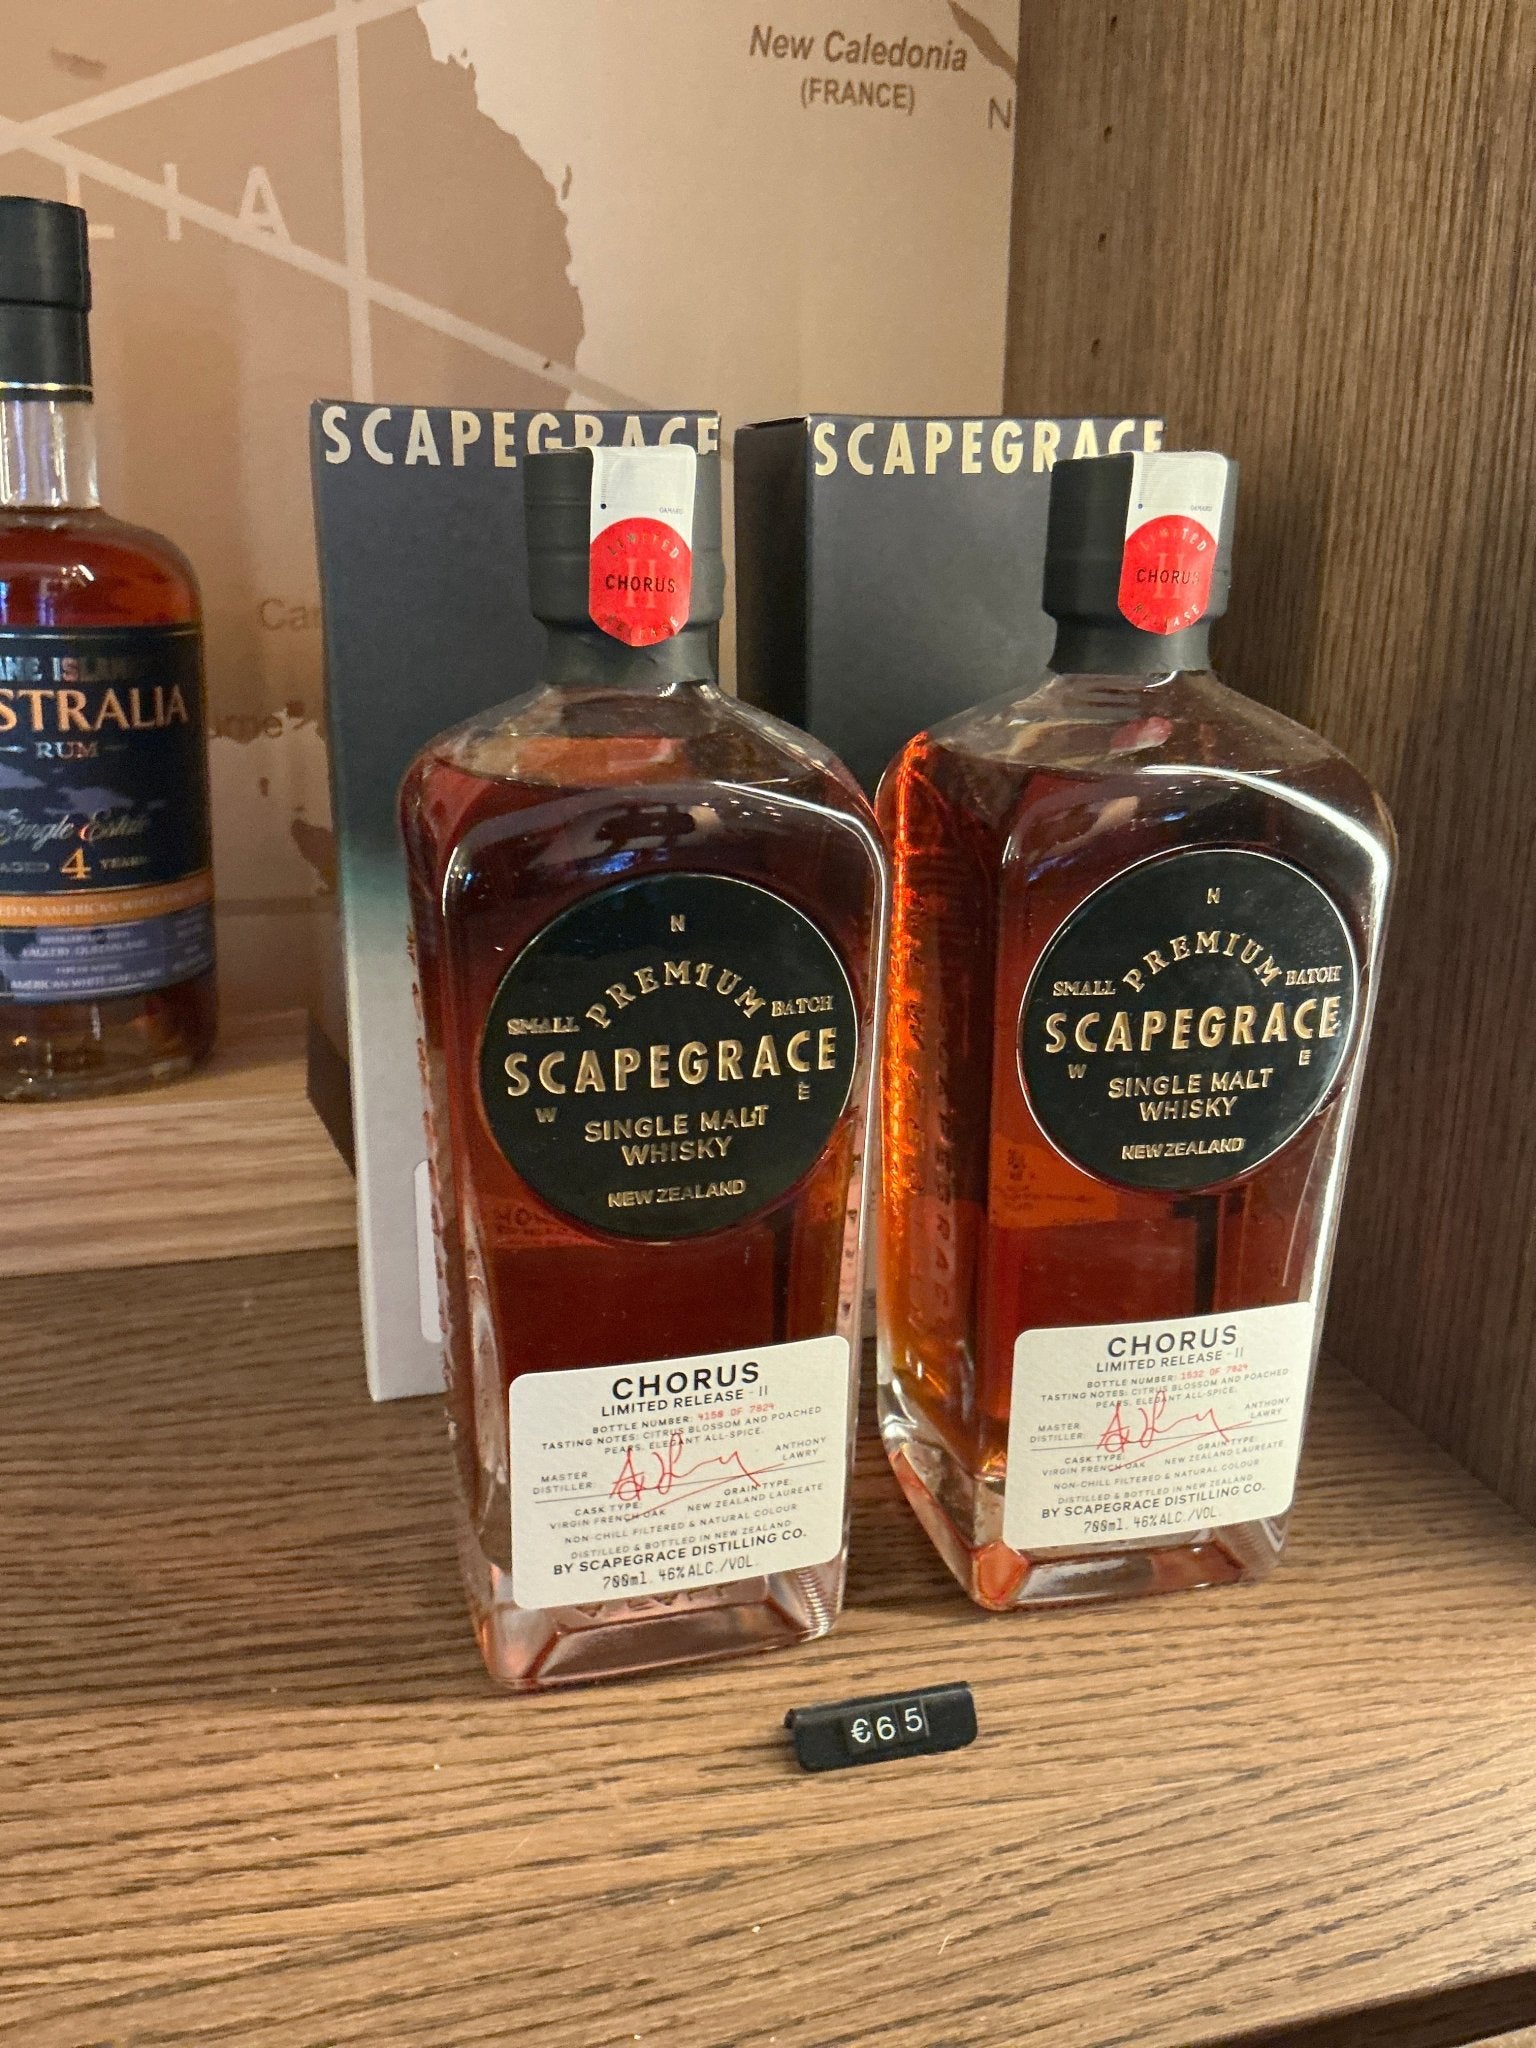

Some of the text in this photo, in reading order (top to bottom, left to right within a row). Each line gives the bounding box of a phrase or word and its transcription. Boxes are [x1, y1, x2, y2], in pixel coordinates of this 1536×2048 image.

[749, 24, 968, 72] New Caledonia
[800, 77, 916, 116] (FRANCE)
[607, 532, 680, 559] LIMITED
[1139, 527, 1207, 551] LIMITED
[605, 573, 676, 593] CHORUS
[1136, 568, 1201, 585] CHORUS
[34, 741, 99, 760] RUM
[60, 847, 92, 879] 4
[1207, 887, 1221, 904] N
[670, 914, 685, 932] N
[1122, 930, 1283, 992] PREMIUM
[1285, 965, 1343, 986] BATCH
[586, 960, 766, 1029] PREMIUM
[1052, 980, 1117, 997] SMALL
[771, 996, 834, 1017] BATCH
[507, 1016, 580, 1036] SMALL
[1045, 995, 1341, 1053] SCAPEGRACE
[504, 1027, 837, 1097] SCAPEGRACE
[1298, 1048, 1311, 1065] E
[1067, 1063, 1087, 1079] W
[1108, 1067, 1274, 1098] SINGLE MALT
[798, 1082, 811, 1100] E
[535, 1106, 558, 1123] W
[1139, 1096, 1238, 1122] WHISKY
[584, 1104, 769, 1142] SINGLE MALT
[621, 1135, 733, 1166] WHISKY
[1121, 1137, 1246, 1160] NEW ZEALAND
[607, 1179, 746, 1208] NEW ZEALAND
[1108, 1324, 1237, 1358] CHORUS
[1096, 1358, 1156, 1373] LIMITED
[1160, 1349, 1223, 1368] RELEASE
[612, 1362, 760, 1400] CHORUS
[1041, 1392, 1087, 1402] TASTING
[1131, 1384, 1168, 1396] CITRUS
[1171, 1379, 1218, 1392] BLOSSOM
[1220, 1375, 1242, 1385] AND
[1243, 1367, 1289, 1381] POACHED
[1087, 1378, 1127, 1389] BOTTLE
[1209, 1367, 1221, 1376] OF
[601, 1399, 668, 1417] LIMITED
[673, 1389, 744, 1408] RELEASE
[1244, 1396, 1290, 1410] ANTHONY
[1250, 1407, 1282, 1419] LAWRY
[541, 1438, 593, 1451] TASTING
[643, 1428, 684, 1440] CITRUS
[688, 1420, 740, 1434] BLOSSOM
[745, 1415, 767, 1426] AND
[771, 1406, 822, 1421] POACHED
[592, 1422, 637, 1434] BOTTLE
[730, 1407, 743, 1417] OF
[1037, 1422, 1080, 1432] MASTER
[775, 1436, 827, 1452] ANTHONY
[782, 1449, 819, 1461] LAWRY
[1197, 1441, 1227, 1451] GRAIN
[1064, 1456, 1092, 1465] CASK
[1165, 1455, 1186, 1465] NEW
[1189, 1449, 1233, 1463] ZEALAND
[541, 1471, 588, 1482] MASTER
[1042, 1461, 1146, 1477] VIRGIN FRENCH OAK
[1053, 1480, 1110, 1490] NON-CHILL
[1114, 1474, 1161, 1485] FILTERED
[1174, 1466, 1217, 1477] NATURAL
[1221, 1458, 1260, 1472] COLOUR
[723, 1484, 758, 1497] GRAIN
[1041, 1482, 1266, 1519] BY SCAPEGRACE DISTILLING CO.
[1057, 1493, 1110, 1505] DISTILLED
[1124, 1487, 1169, 1499] BOTTLED
[1172, 1485, 1182, 1493] IN
[1186, 1480, 1206, 1490] NEW
[1209, 1473, 1254, 1488] ZEALAND
[574, 1505, 605, 1517] CASK
[687, 1501, 712, 1512] NEW
[715, 1493, 766, 1508] ZEALAND
[549, 1509, 666, 1530] VIRGIN FRENCH OAK
[564, 1531, 629, 1544] NON-CHILL
[633, 1522, 685, 1536] FILTERED
[700, 1513, 749, 1526] NATURAL
[754, 1503, 797, 1518] COLOUR
[553, 1527, 807, 1575] BY SCAPEGRACE DISTILLING CO.
[571, 1545, 630, 1560] DISTILLED
[644, 1536, 695, 1550] BOTTLED
[700, 1533, 711, 1541] IN
[714, 1528, 738, 1539] NEW
[742, 1519, 792, 1535] ZEALAND
[851, 1707, 923, 1743] €65
